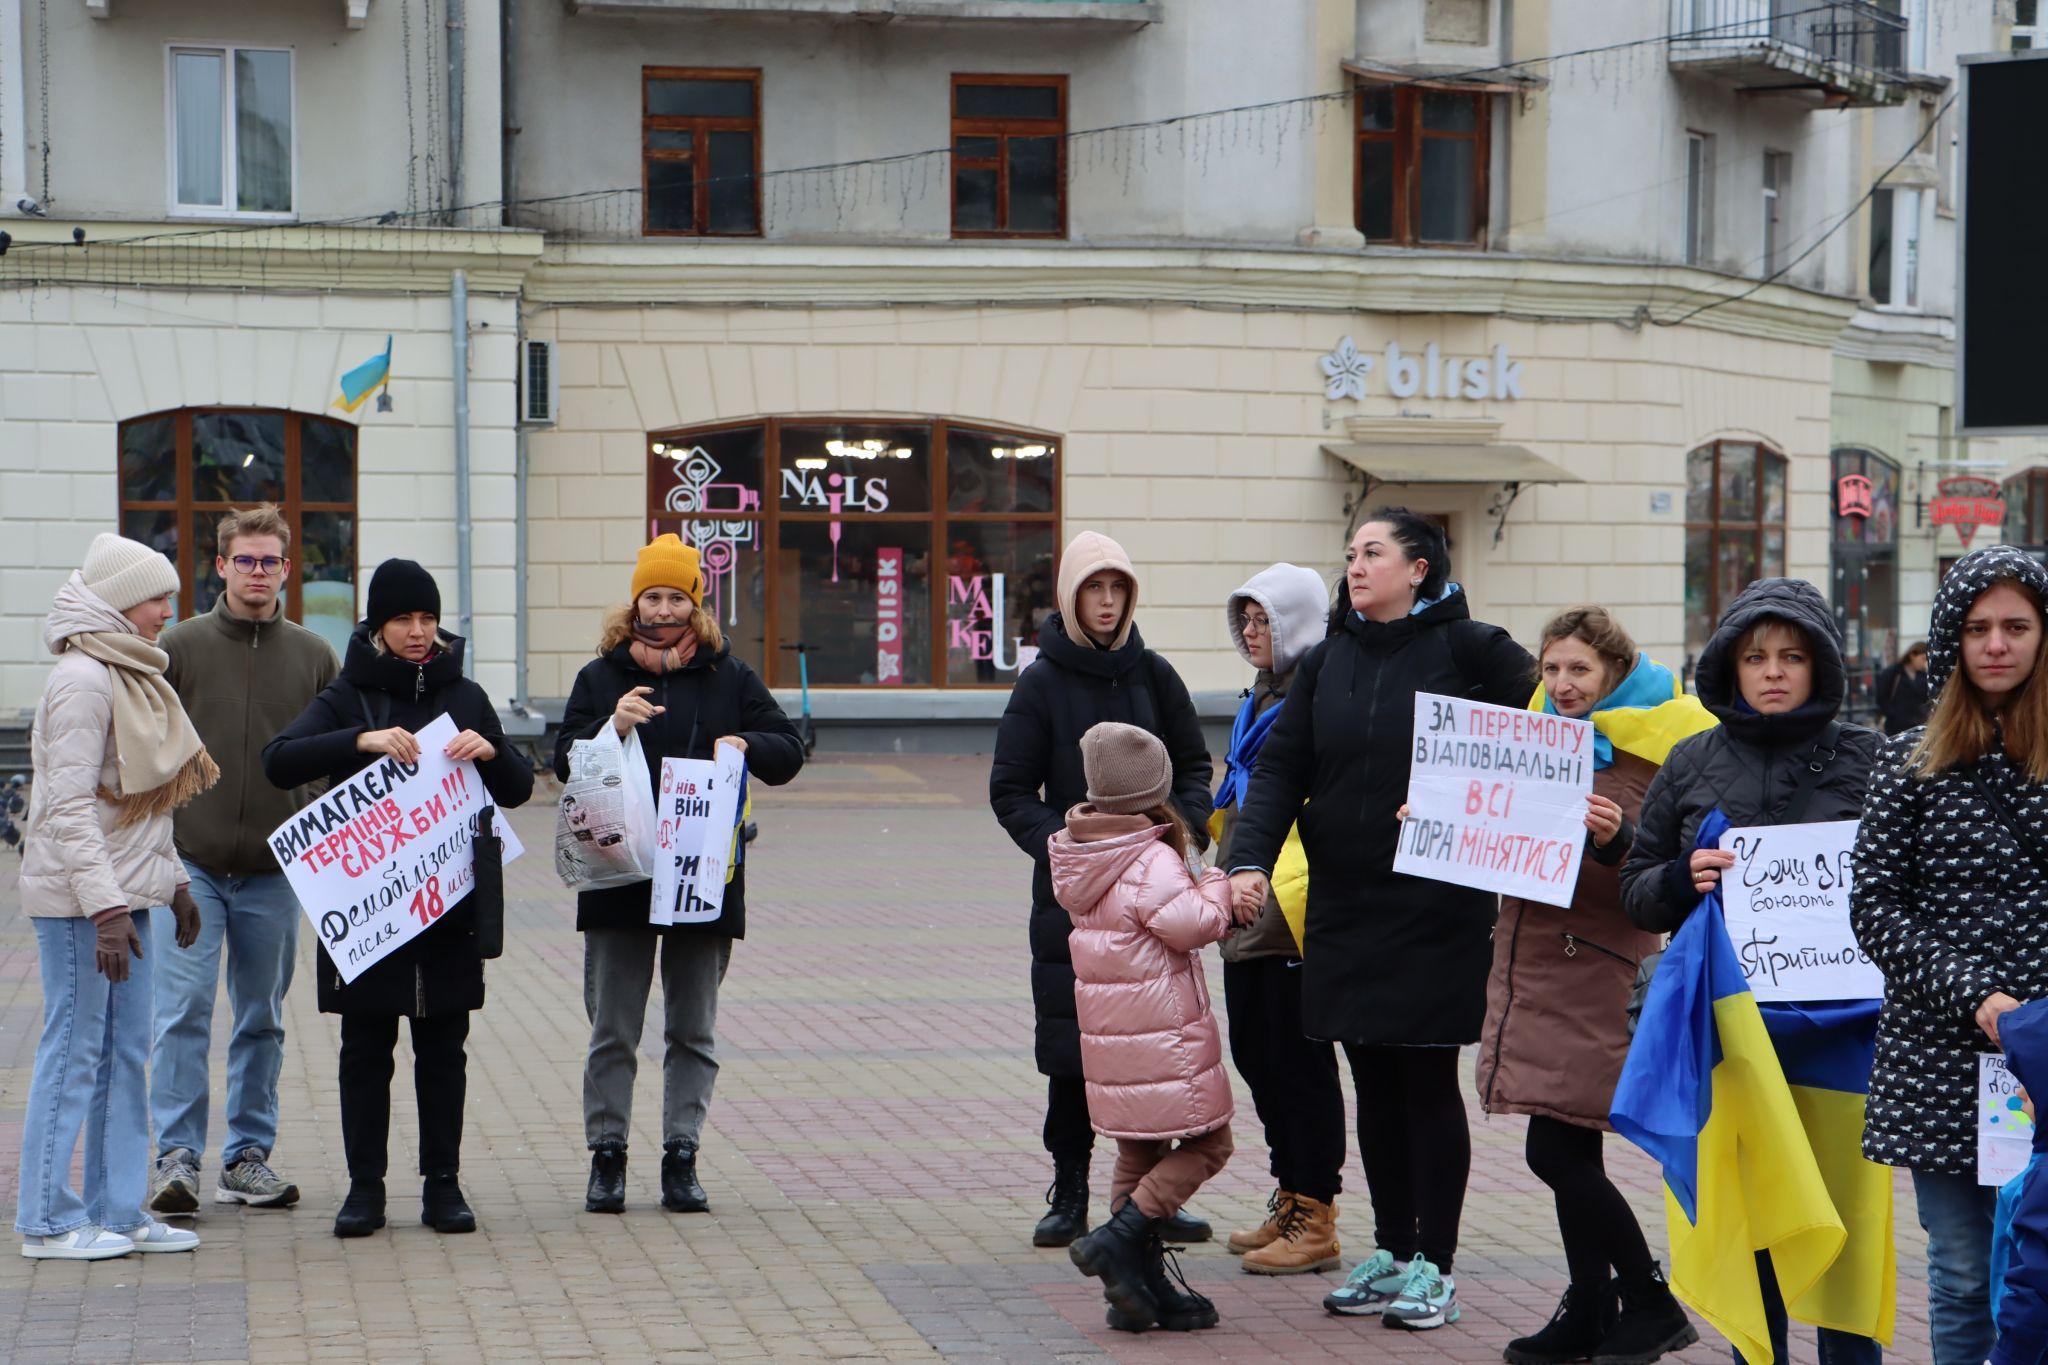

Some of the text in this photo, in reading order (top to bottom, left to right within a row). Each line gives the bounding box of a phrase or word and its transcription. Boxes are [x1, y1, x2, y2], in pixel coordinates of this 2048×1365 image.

[1429, 701, 1585, 754] ЗА ПЕРЕМОГУ
[1416, 733, 1583, 786] ВІДПОВІДАЛЬНІ
[274, 758, 419, 867] ВИМАГАЄМО
[1465, 779, 1515, 819] ВСІ
[300, 798, 401, 874] ТЕРМІНІВ
[1398, 816, 1573, 884] ПОРА МІНЯТИСЯ
[1733, 836, 1809, 887] Чому
[348, 920, 399, 965] після
[410, 875, 445, 926] 18
[1750, 887, 1834, 912] воюють
